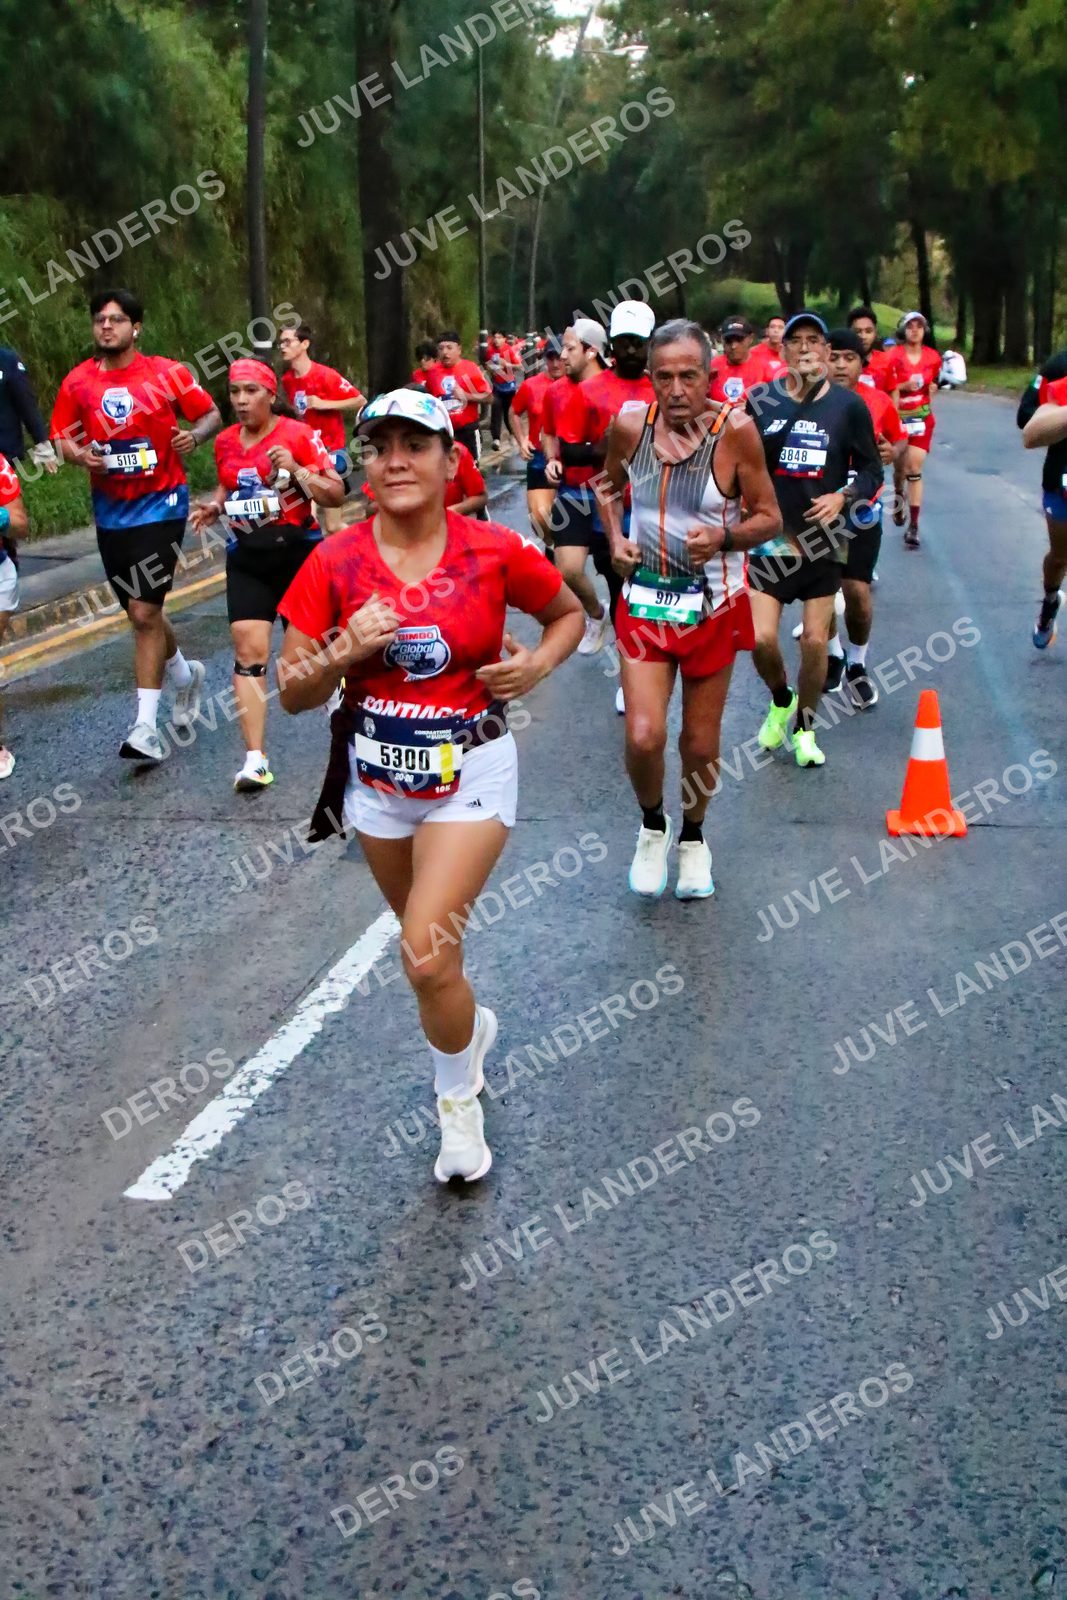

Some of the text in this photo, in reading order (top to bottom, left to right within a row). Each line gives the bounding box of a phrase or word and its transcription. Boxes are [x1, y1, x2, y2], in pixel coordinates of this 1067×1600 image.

[117, 454, 138, 467] 5113
[243, 500, 261, 512] 4111
[655, 590, 681, 606] 907
[400, 642, 435, 654] Global
[380, 745, 430, 772] 5300
[434, 785, 451, 793] 10K
